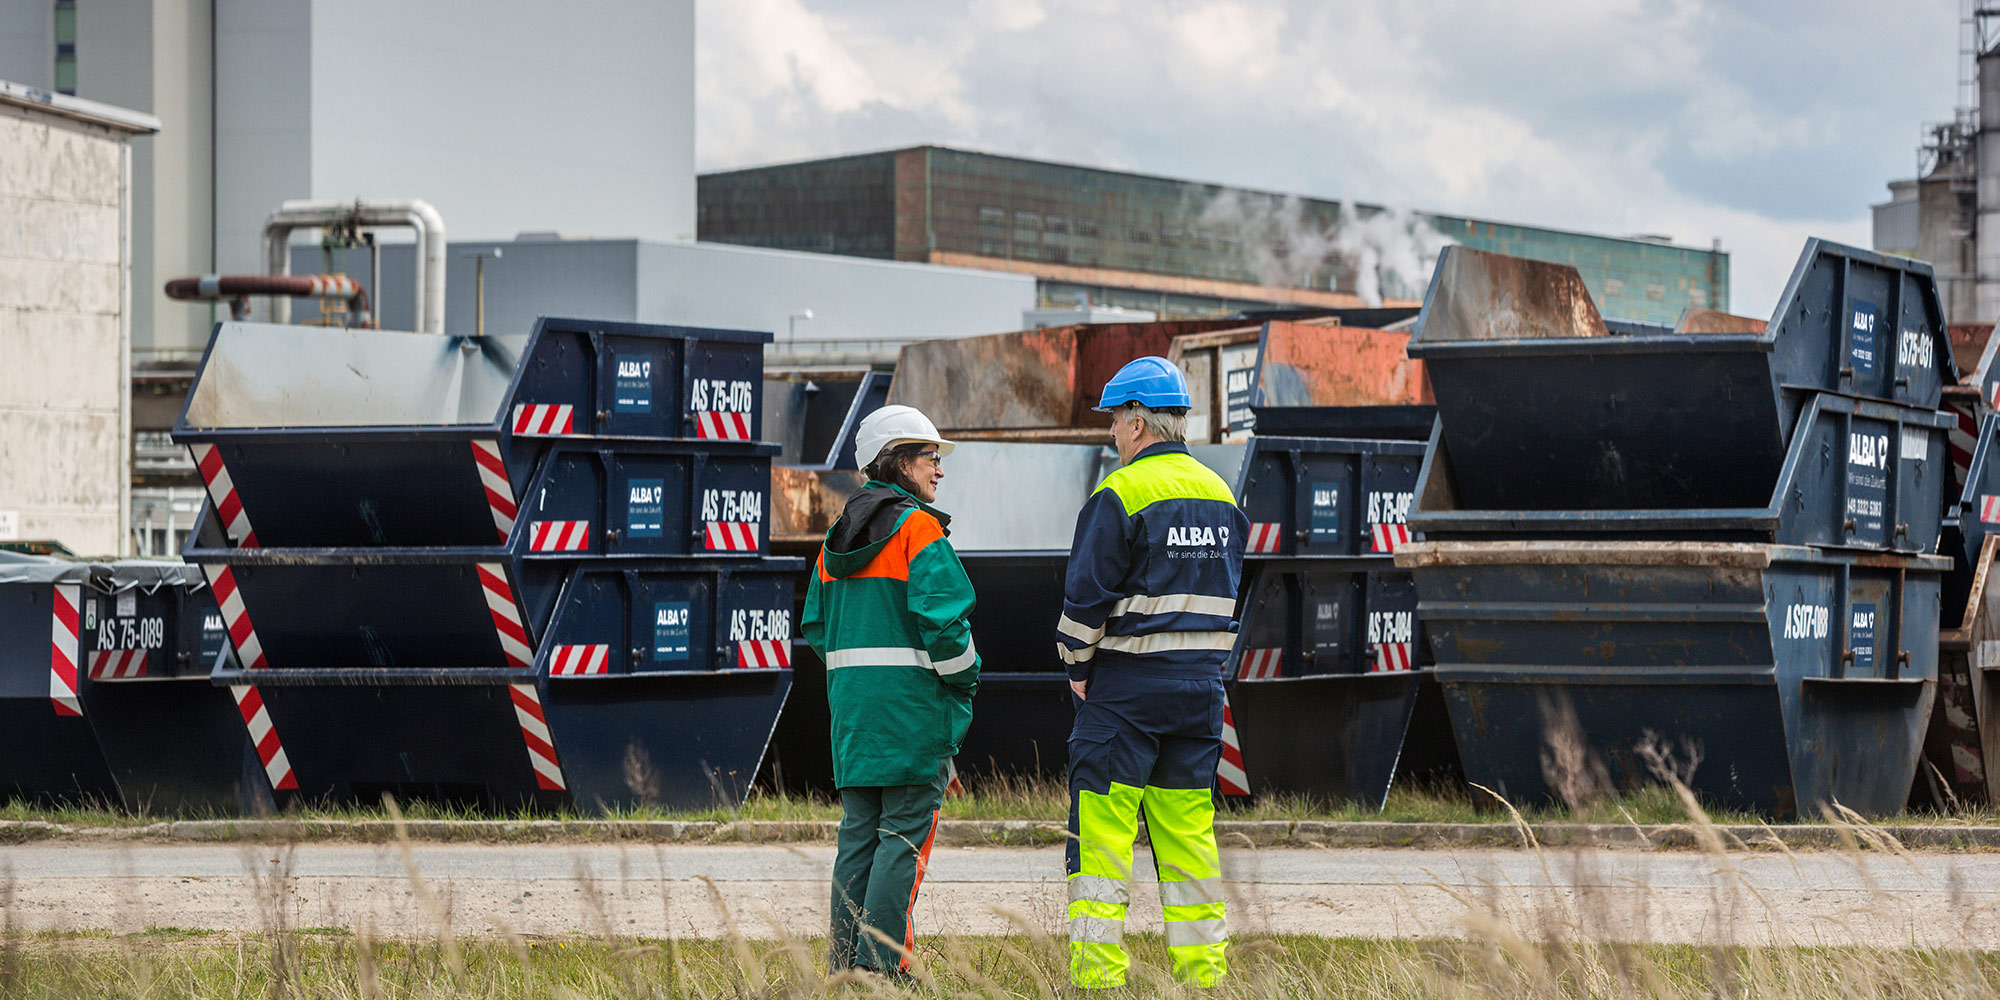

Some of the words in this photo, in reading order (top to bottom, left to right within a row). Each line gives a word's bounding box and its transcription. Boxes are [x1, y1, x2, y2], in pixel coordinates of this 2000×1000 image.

[1853, 311, 1868, 331] ALBA
[618, 361, 641, 378] ALBA
[691, 378, 708, 412] AS
[711, 379, 752, 413] 75-076
[1848, 432, 1876, 467] ALBA
[630, 487, 653, 504] ALBA
[701, 488, 719, 522] AS
[722, 490, 762, 523] 75-094
[1313, 489, 1331, 506] ALBA
[1367, 491, 1380, 524] AS
[1166, 526, 1216, 546] ALBA
[1167, 550, 1178, 559] Wir
[1181, 550, 1196, 559] sind
[1197, 550, 1208, 559] die
[656, 609, 679, 626] ALBA
[1317, 603, 1332, 620] ALBA
[1853, 612, 1868, 628] ALBA
[97, 618, 116, 650] AS
[120, 617, 164, 649] 75-089
[729, 608, 746, 641] AS
[749, 609, 790, 641] 75-086
[1368, 611, 1381, 643] AS
[1383, 611, 1412, 643] 75-084
